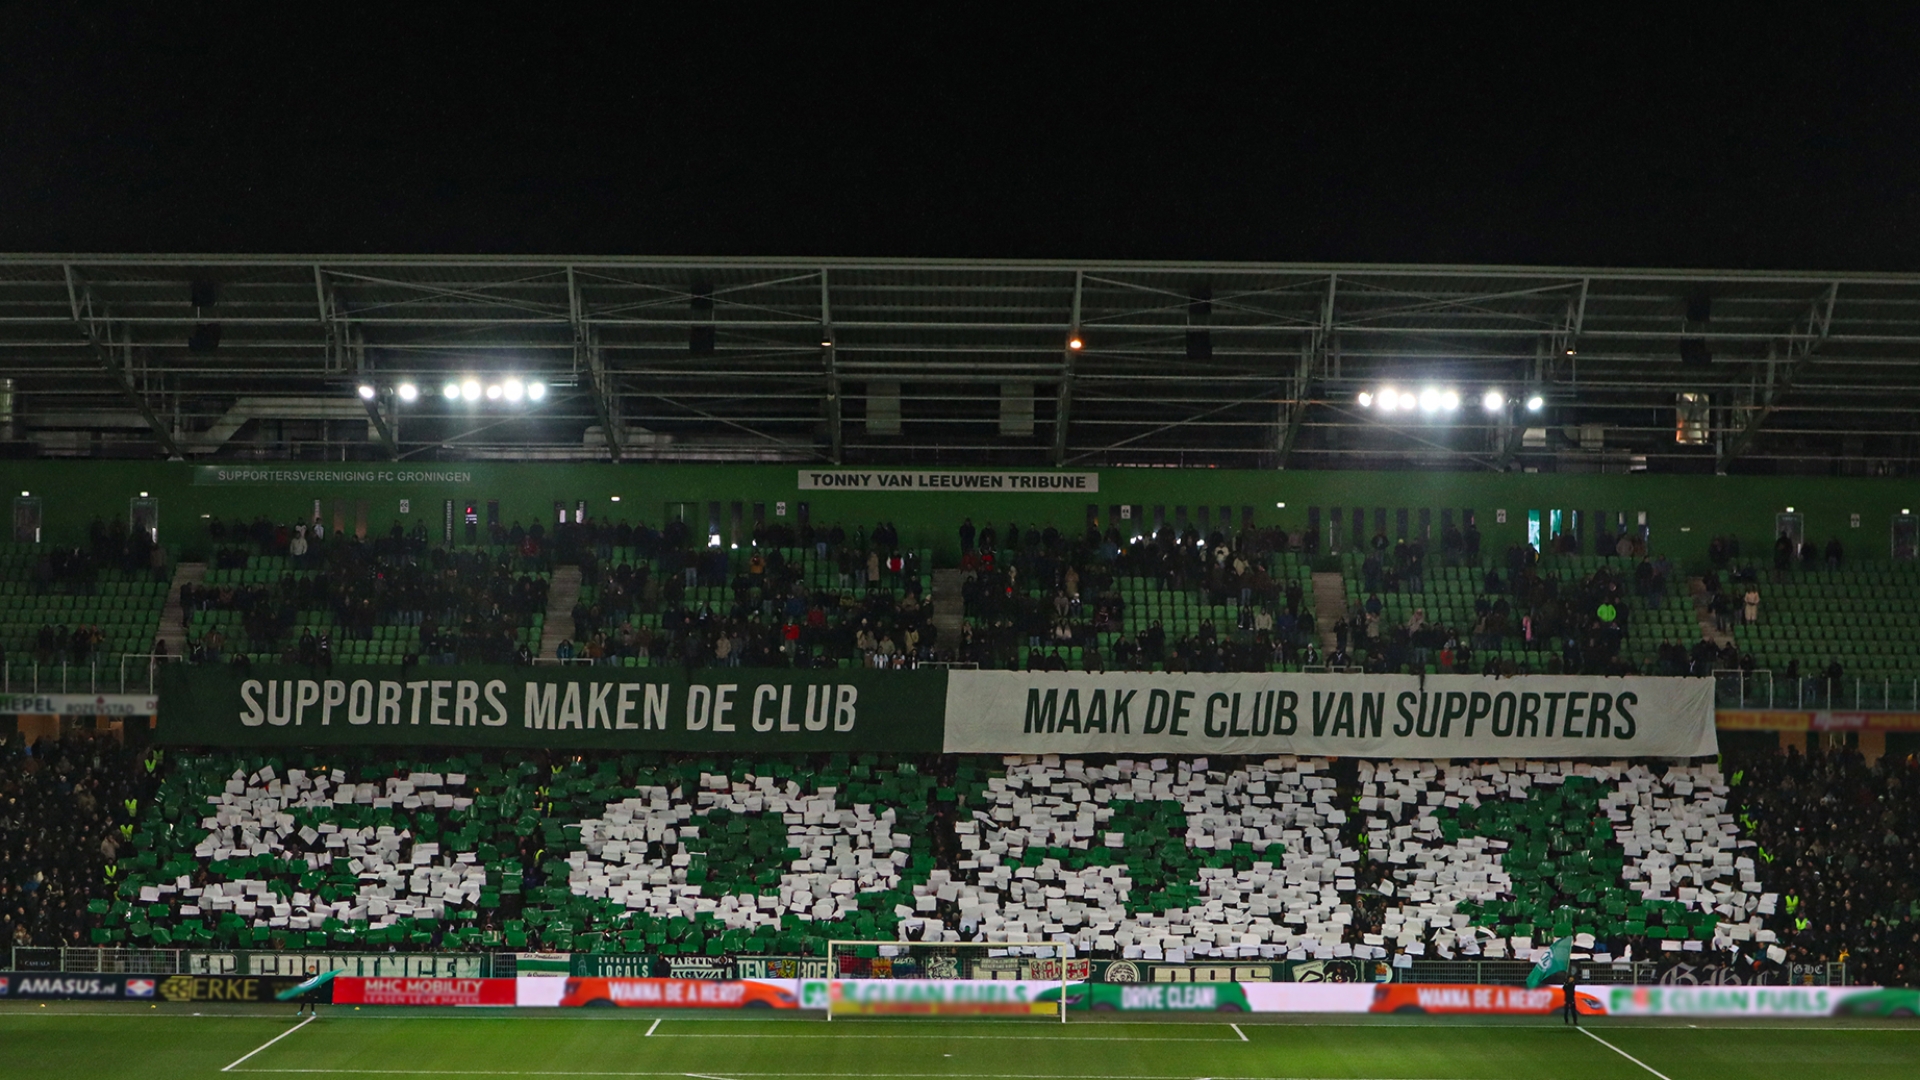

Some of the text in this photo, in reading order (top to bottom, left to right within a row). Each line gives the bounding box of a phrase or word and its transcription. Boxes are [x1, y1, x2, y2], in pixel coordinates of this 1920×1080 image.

[218, 470, 471, 482] SUPPORTERSVERENIGING FC GRONINGEN
[811, 473, 1086, 489] TONNY VAN LEEUWEN TRIBUNE
[239, 679, 858, 732] SUPPORTERS MAKEN DE CLUB
[1024, 688, 1638, 740] MAAK DE CLUB VAN SUPPORTERS
[598, 965, 649, 977] LOCALS
[737, 960, 766, 979] TEN
[18, 977, 116, 995] AMASUS.nl
[365, 979, 483, 995] MHC MOBILITY
[608, 981, 745, 1002] WANNA BE A HERO?
[953, 984, 1027, 1003] FUELS
[1121, 986, 1164, 1009] DRIVE
[1417, 988, 1470, 1008] WANNA
[1474, 989, 1492, 1008] BE
[1496, 989, 1506, 1008] A
[1757, 991, 1829, 1011] FUELS
